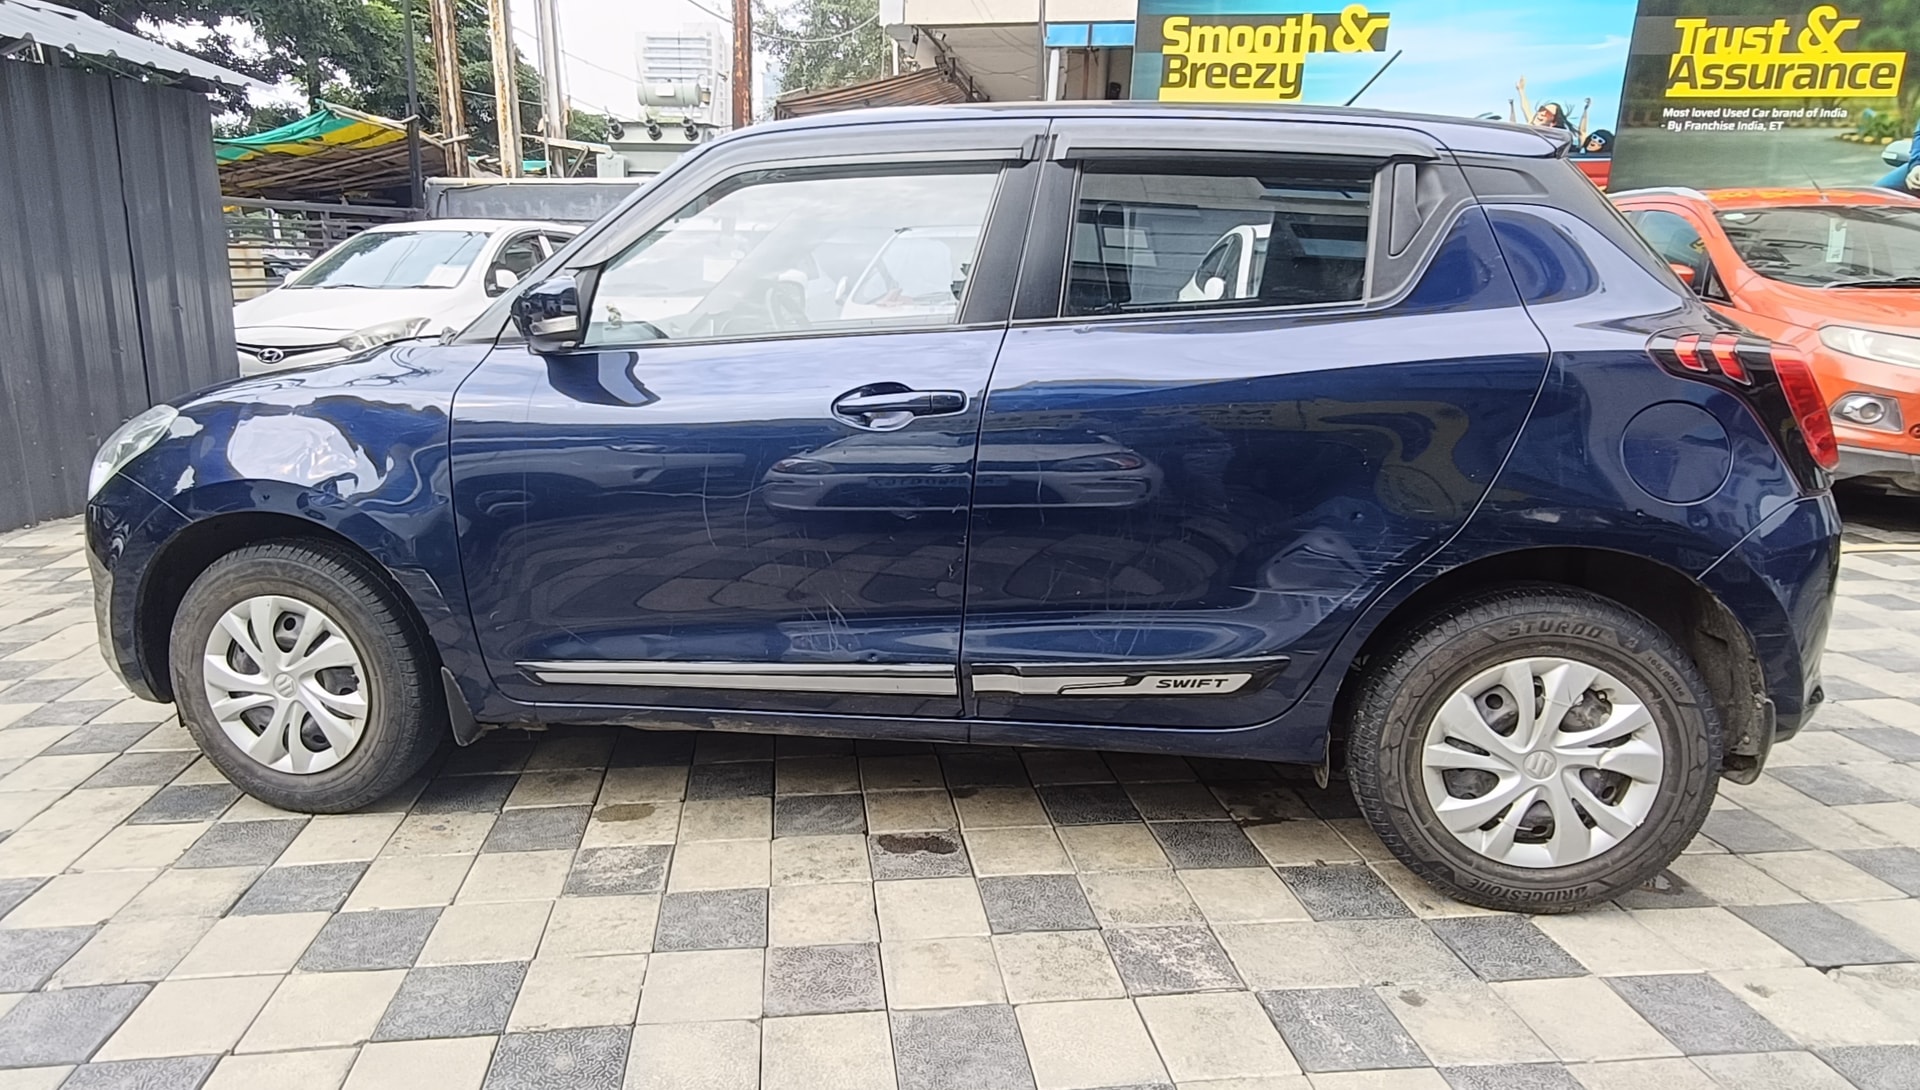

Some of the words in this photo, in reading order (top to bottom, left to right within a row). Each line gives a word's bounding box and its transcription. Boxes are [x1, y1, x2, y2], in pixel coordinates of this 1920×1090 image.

[1162, 13, 1327, 54] Smooth
[1332, 4, 1391, 53] &
[1675, 18, 1791, 54] Trust
[1797, 5, 1861, 53] &
[1162, 54, 1305, 99] Breezy
[1667, 55, 1897, 89] Assurance
[1663, 108, 1690, 118] Most
[1692, 108, 1720, 118] loved
[1722, 108, 1750, 118] Used
[1751, 108, 1769, 118] Car
[1771, 108, 1804, 118] brand
[1805, 108, 1818, 118] of
[1819, 108, 1847, 118] India
[1667, 121, 1682, 132] By
[1684, 121, 1735, 131] Franchise
[1737, 121, 1767, 132] India,
[1769, 121, 1784, 131] ET
[1506, 620, 1604, 639] STURDO
[1156, 678, 1229, 690] SWIFT
[1468, 878, 1588, 903] BRIDGESTONE
